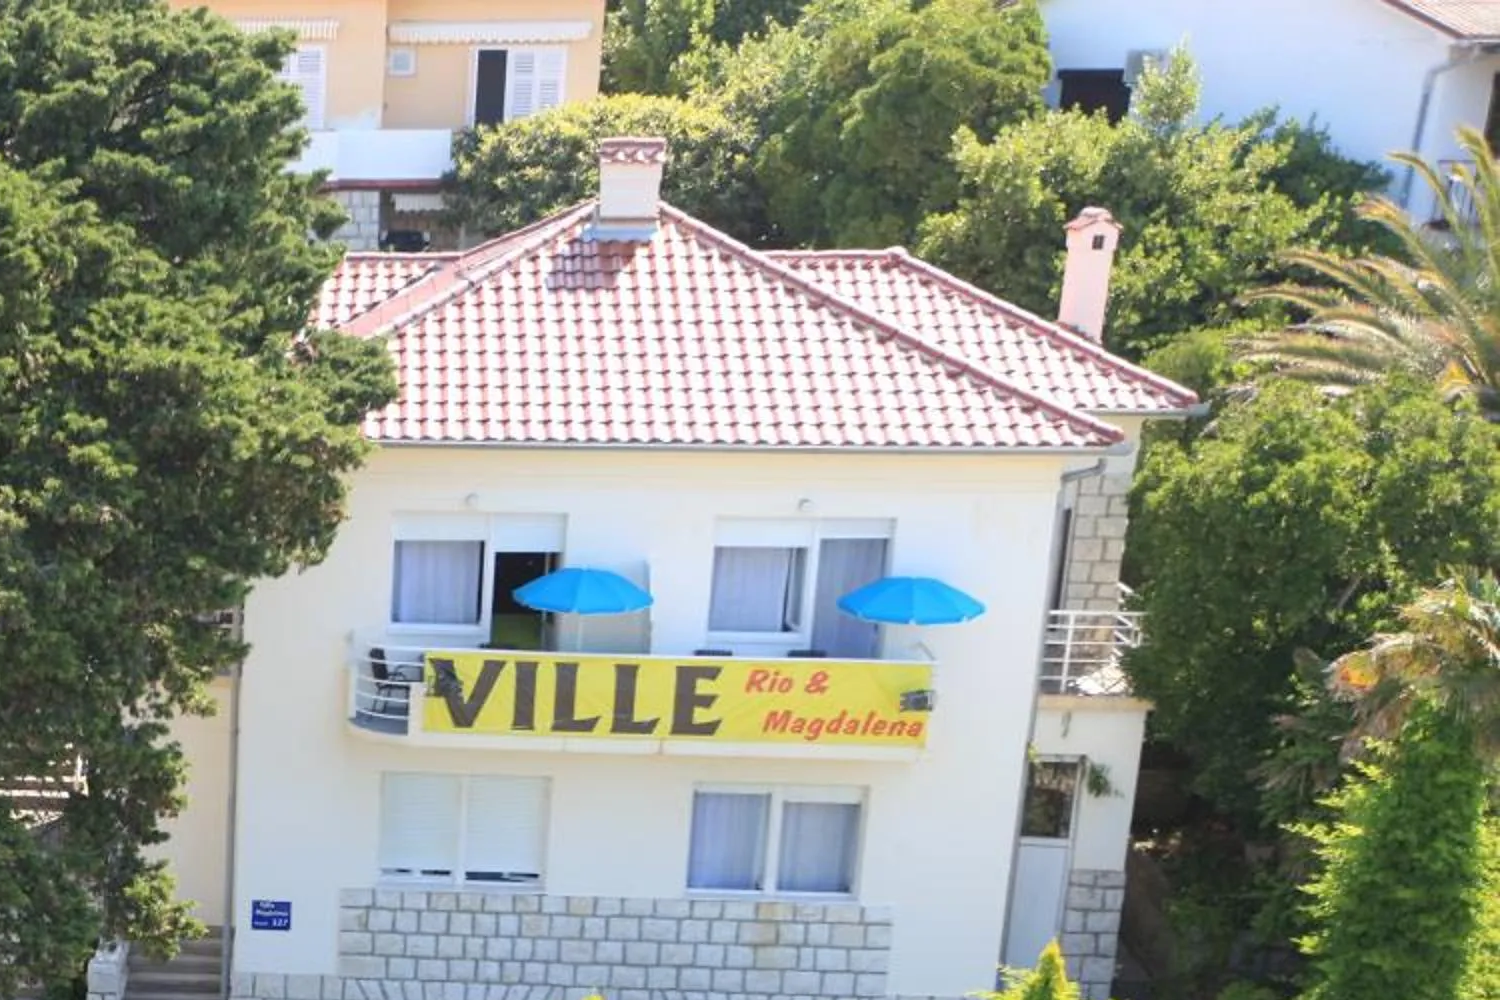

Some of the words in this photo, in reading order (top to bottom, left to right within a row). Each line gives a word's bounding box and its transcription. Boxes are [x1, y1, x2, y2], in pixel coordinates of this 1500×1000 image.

[428, 657, 722, 736] VILLE
[744, 669, 794, 696] Rio
[803, 671, 828, 695] &
[763, 709, 924, 742] Magdalena
